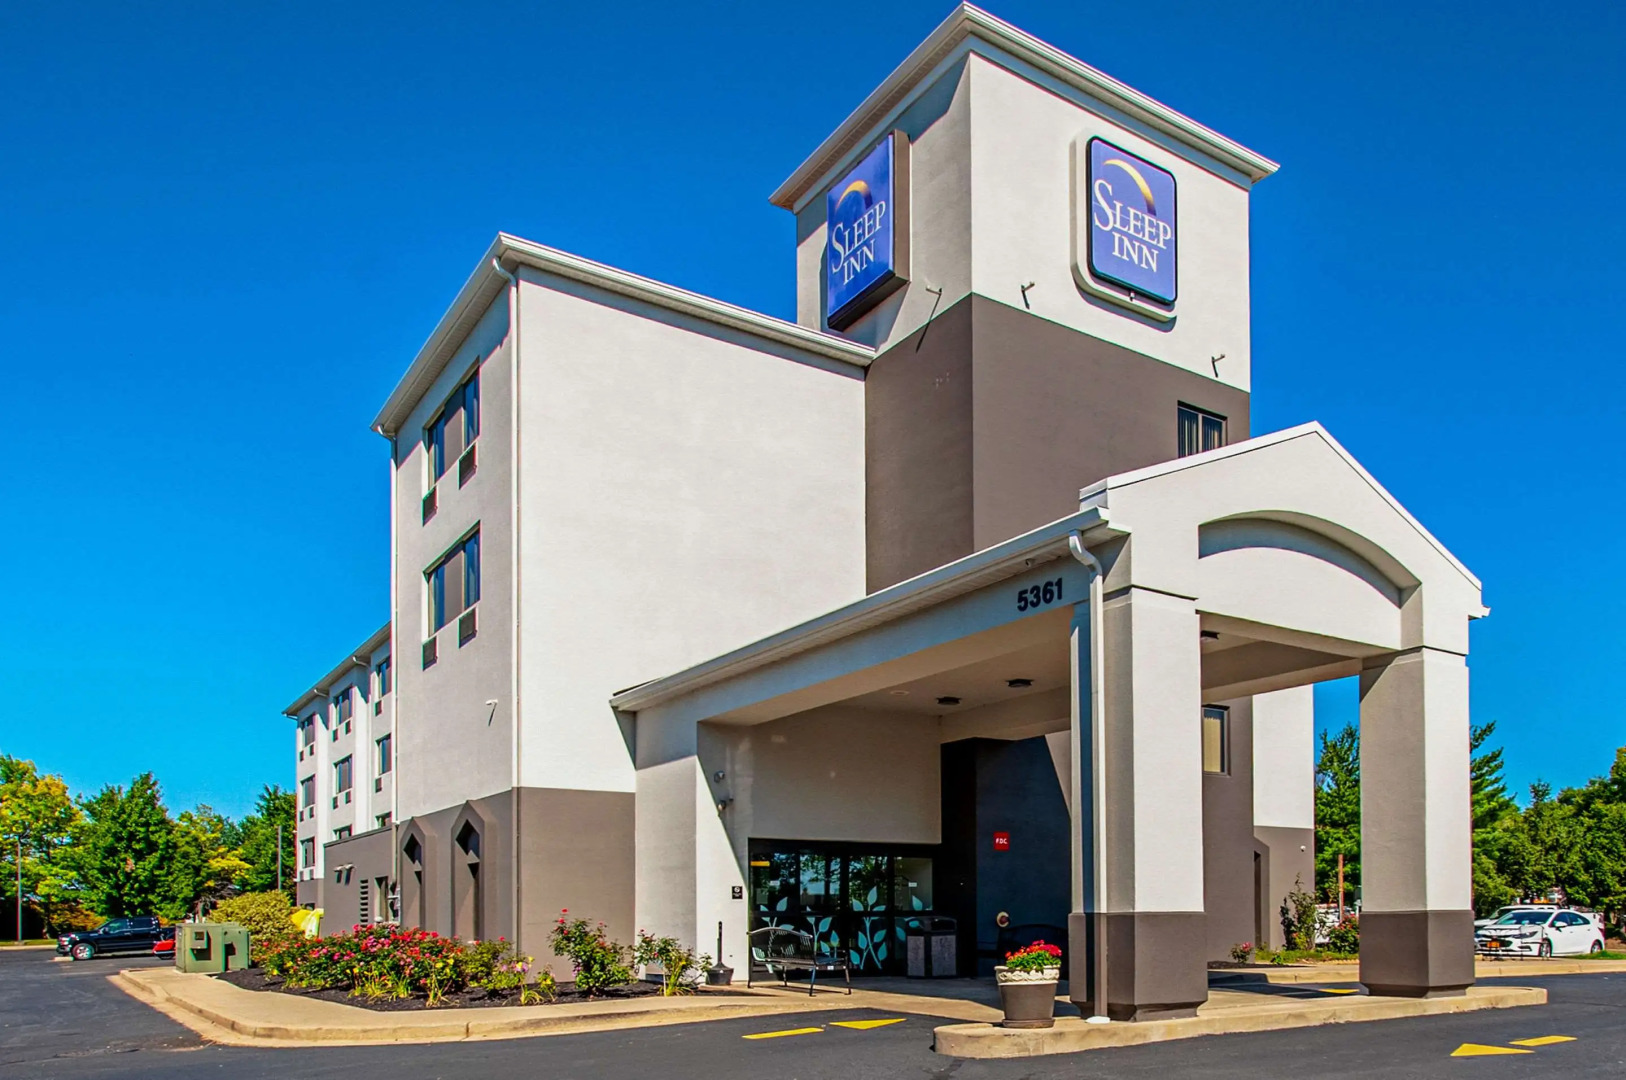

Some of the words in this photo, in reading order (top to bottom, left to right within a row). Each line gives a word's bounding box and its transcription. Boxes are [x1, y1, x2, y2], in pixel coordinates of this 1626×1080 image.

[832, 200, 886, 274] SLEEP
[1094, 179, 1172, 250] SLEEP
[843, 239, 876, 286] INN
[1112, 231, 1159, 273] INN
[1017, 577, 1063, 612] 5361
